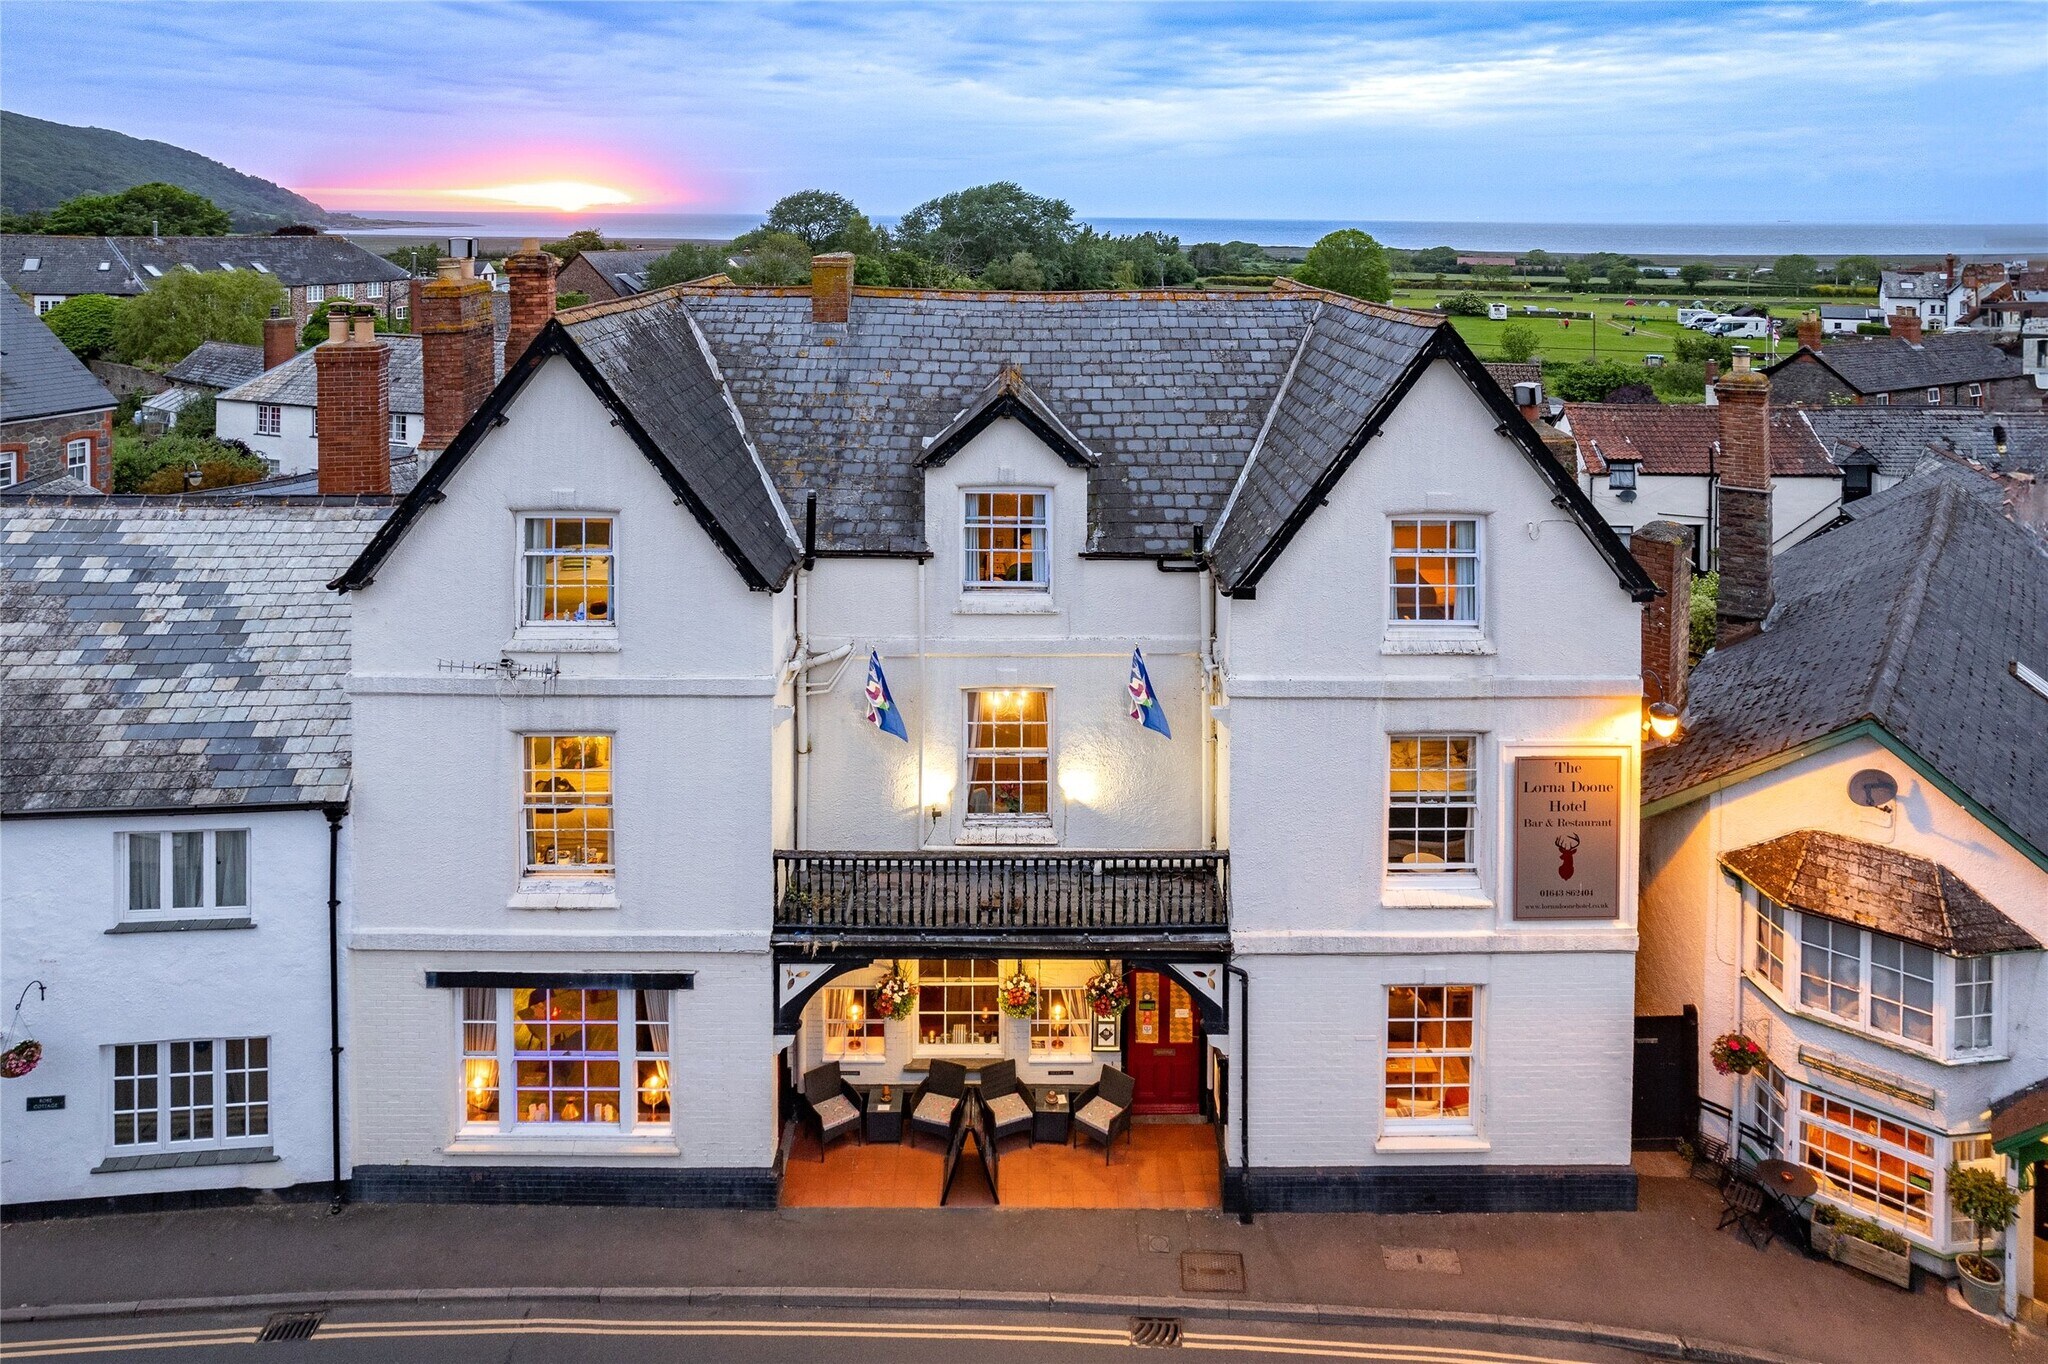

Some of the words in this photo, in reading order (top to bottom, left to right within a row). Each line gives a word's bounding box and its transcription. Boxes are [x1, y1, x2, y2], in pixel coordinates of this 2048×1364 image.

[1554, 761, 1582, 774] The
[1523, 781, 1565, 793] Lorna
[1571, 781, 1614, 793] Doone
[1549, 800, 1587, 812] Hotel
[1523, 818, 1544, 828] Bar
[1545, 819, 1553, 828] &
[1557, 818, 1612, 828] Restaurant
[1539, 889, 1564, 898] 01643
